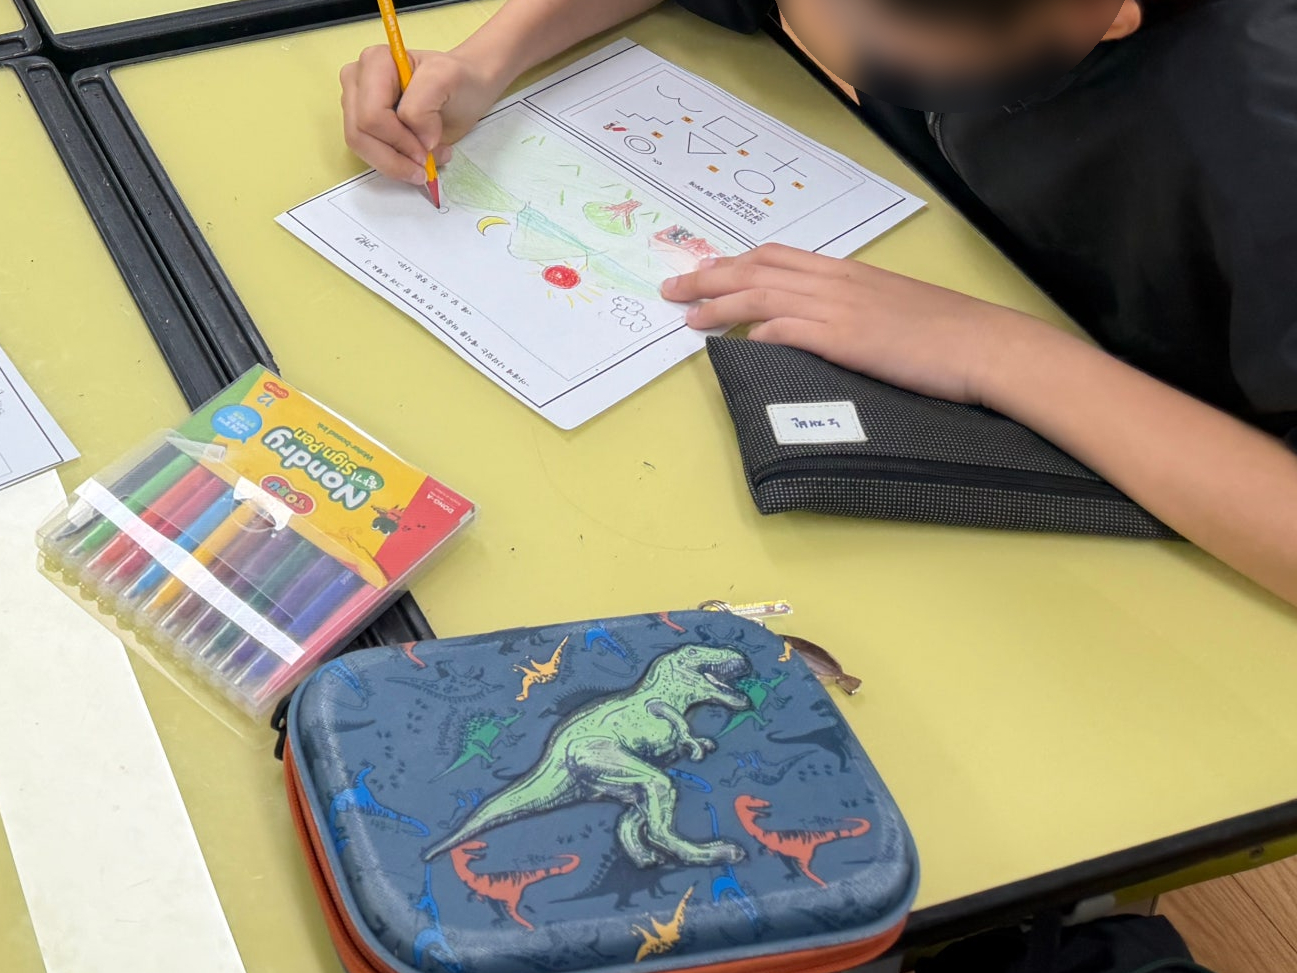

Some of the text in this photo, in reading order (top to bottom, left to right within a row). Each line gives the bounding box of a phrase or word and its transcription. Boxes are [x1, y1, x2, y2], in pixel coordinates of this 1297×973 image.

[263, 427, 367, 509] Nondry
[294, 428, 379, 490] 향기 Sign Pen
[267, 481, 307, 510] TORU
